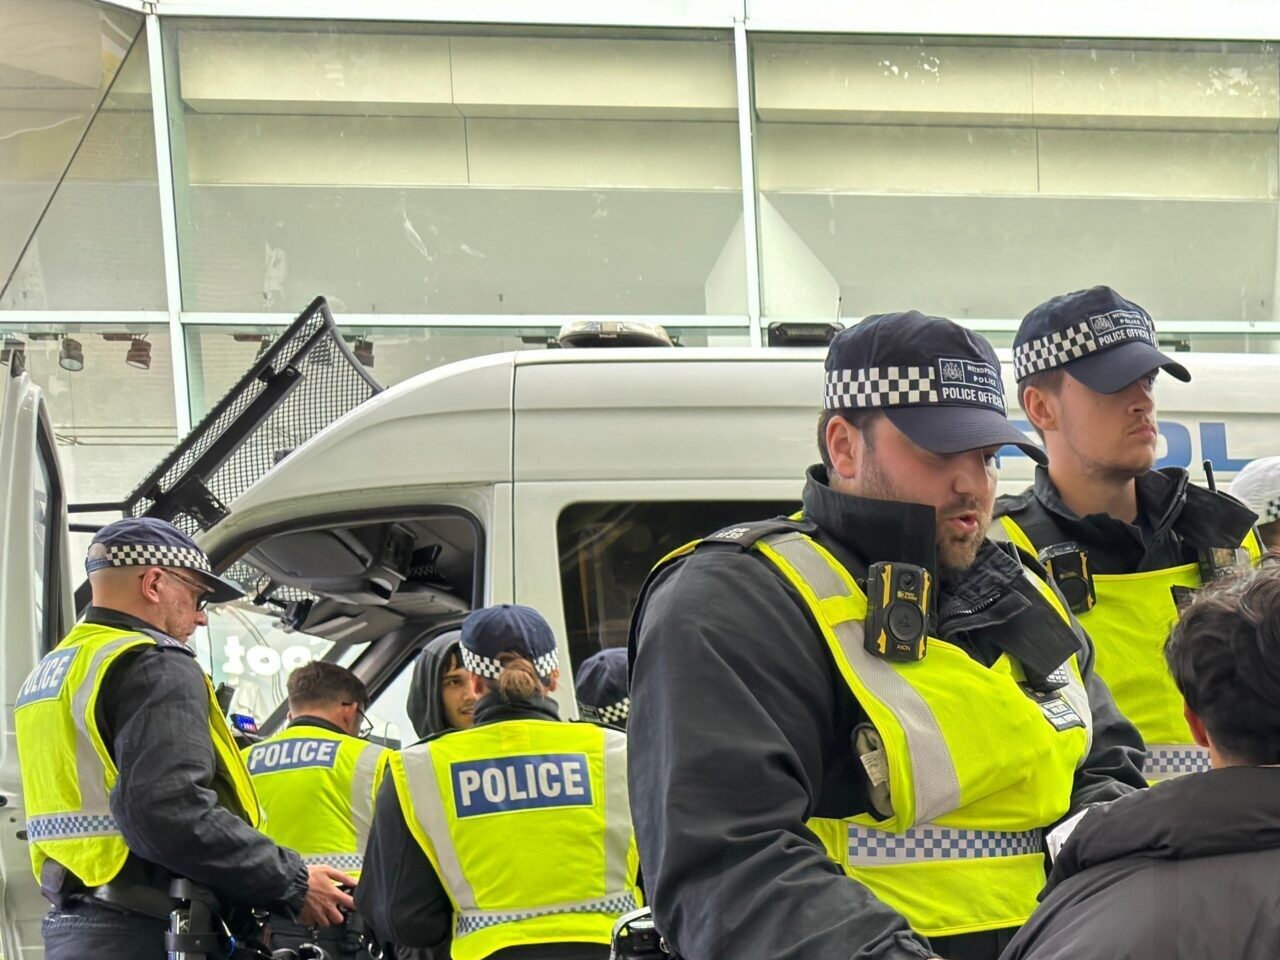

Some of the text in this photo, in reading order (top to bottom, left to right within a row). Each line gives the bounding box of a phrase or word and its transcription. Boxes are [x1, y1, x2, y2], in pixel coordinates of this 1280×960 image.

[1098, 331, 1127, 347] POLICE
[942, 387, 977, 401] POLICE
[24, 656, 71, 696] OLICE
[250, 741, 335, 770] POLICE
[458, 762, 585, 806] POLICE
